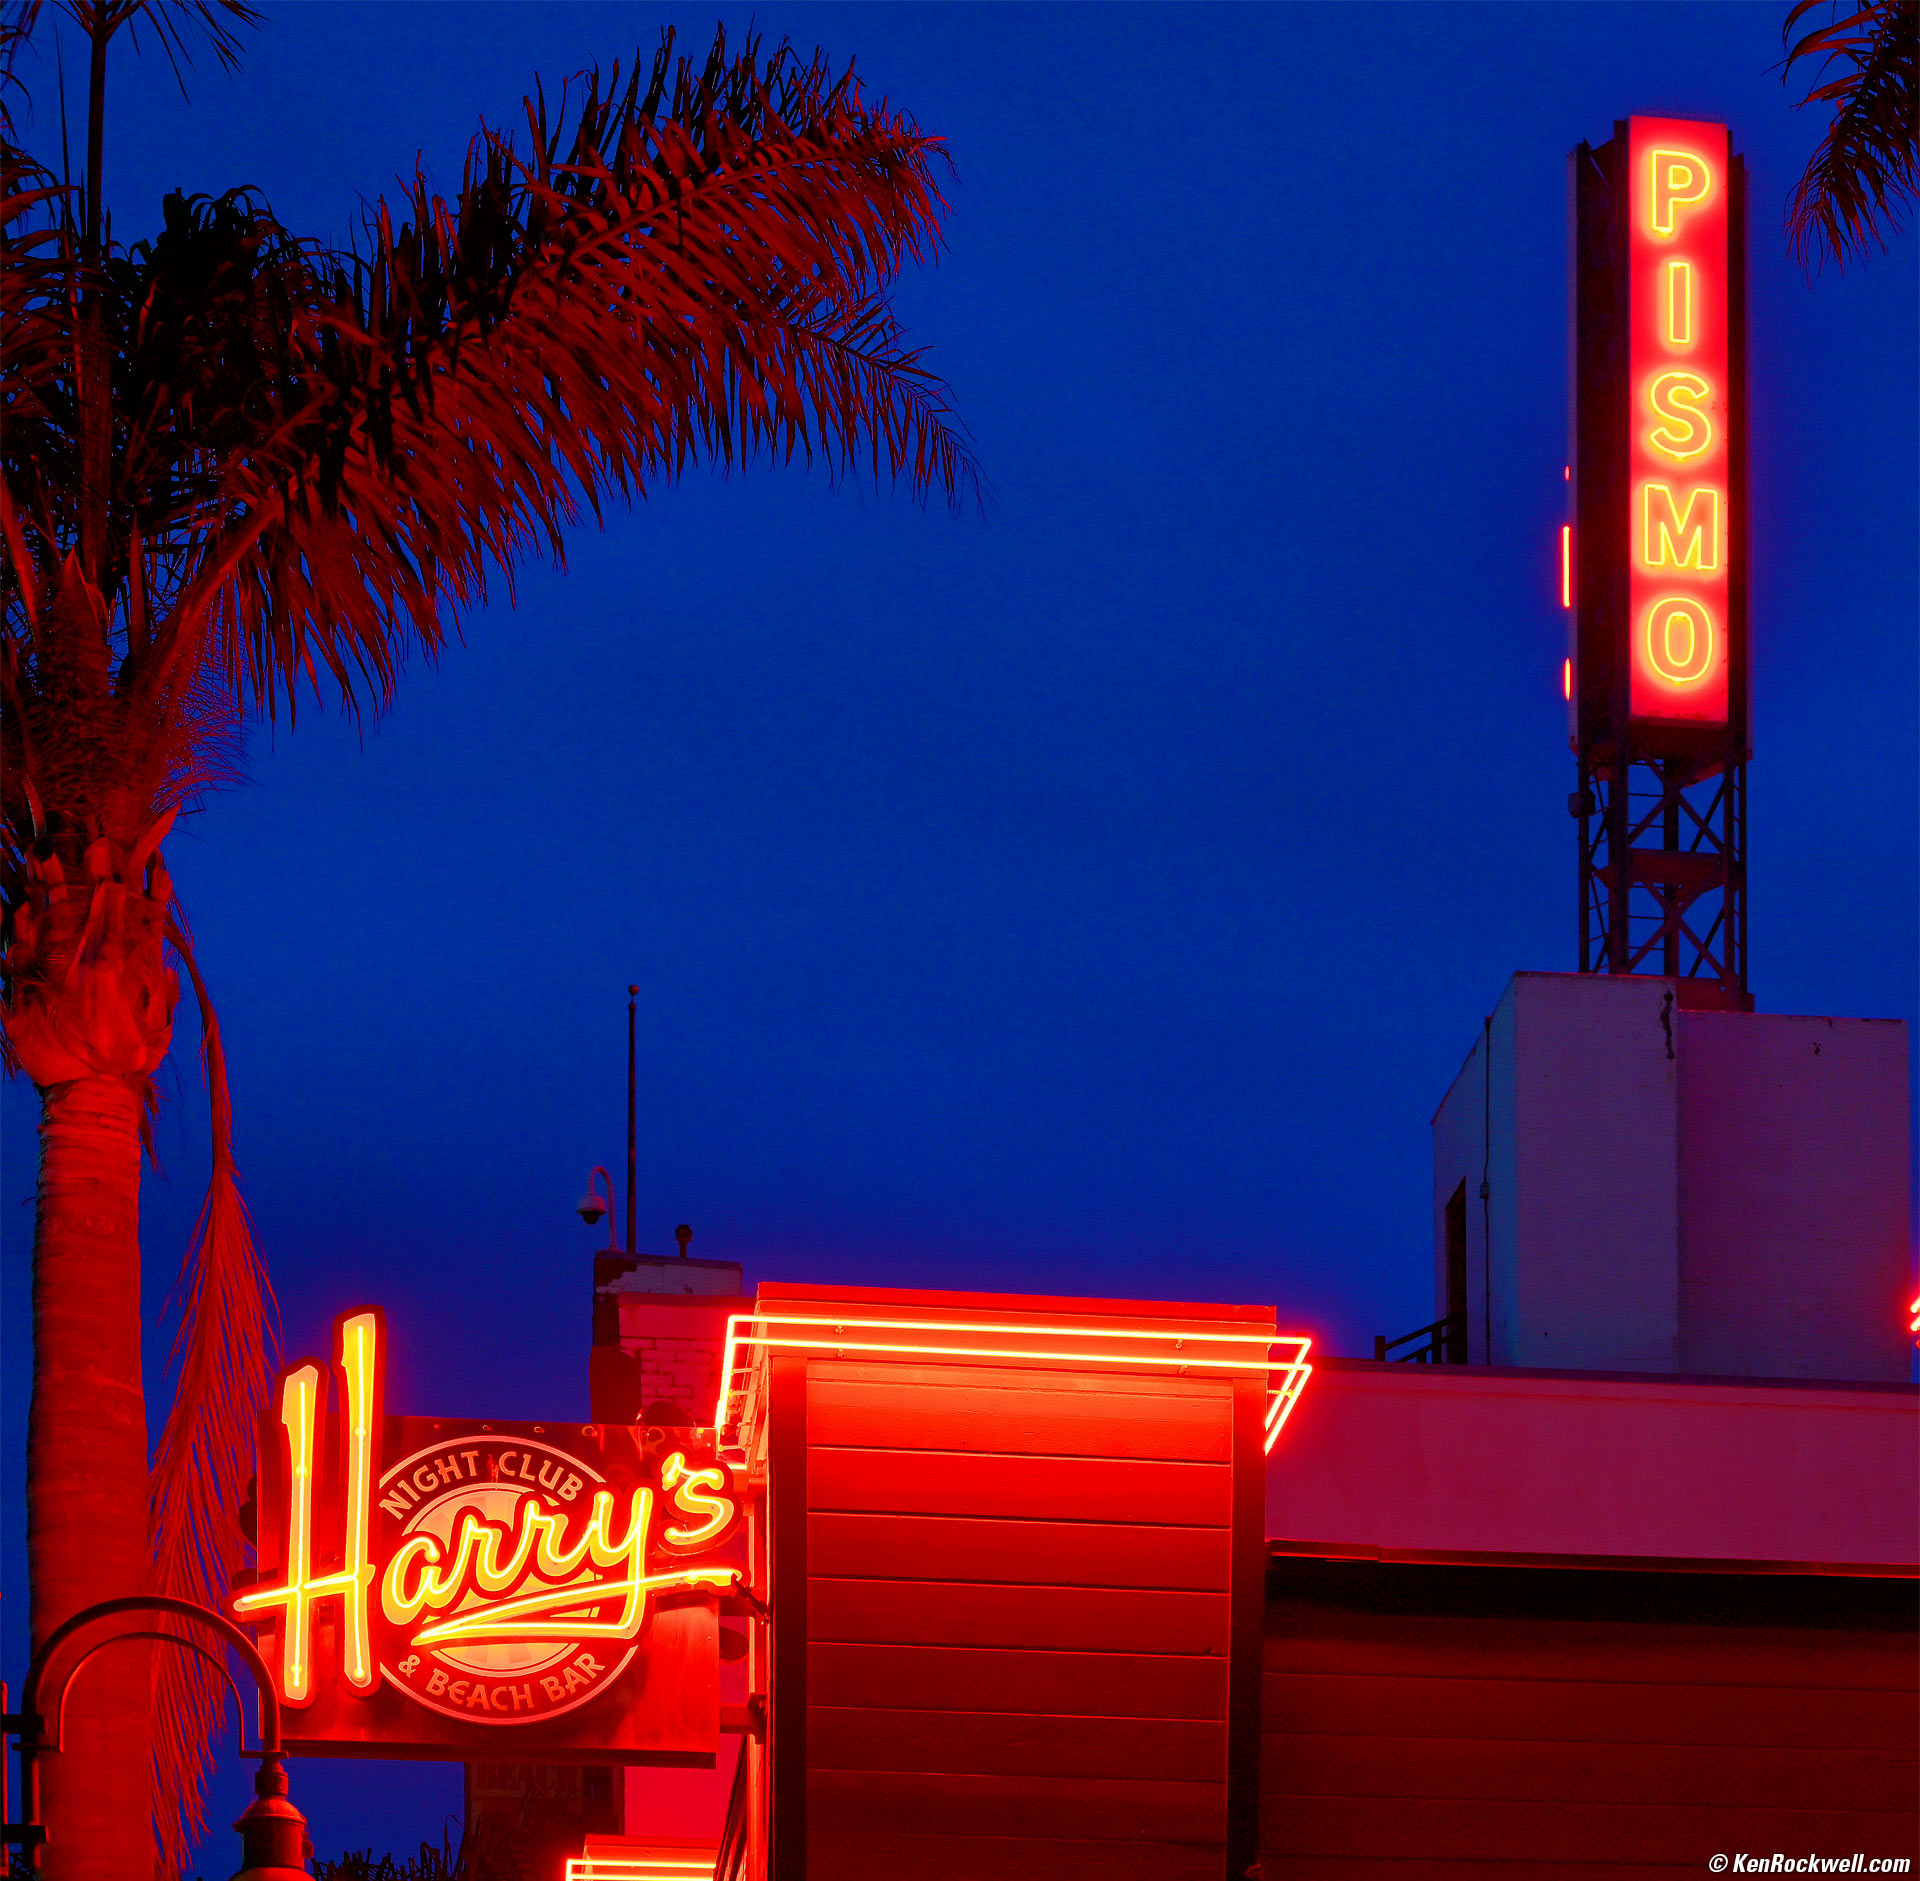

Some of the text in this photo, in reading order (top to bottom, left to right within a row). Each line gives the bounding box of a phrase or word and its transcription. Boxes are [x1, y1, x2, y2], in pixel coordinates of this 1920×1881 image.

[1644, 150, 1718, 684] PISMO
[234, 1313, 742, 1701] Harry's
[379, 1450, 584, 1520] NIGHT CLUB
[398, 1653, 606, 1711] & BEACH BAR
